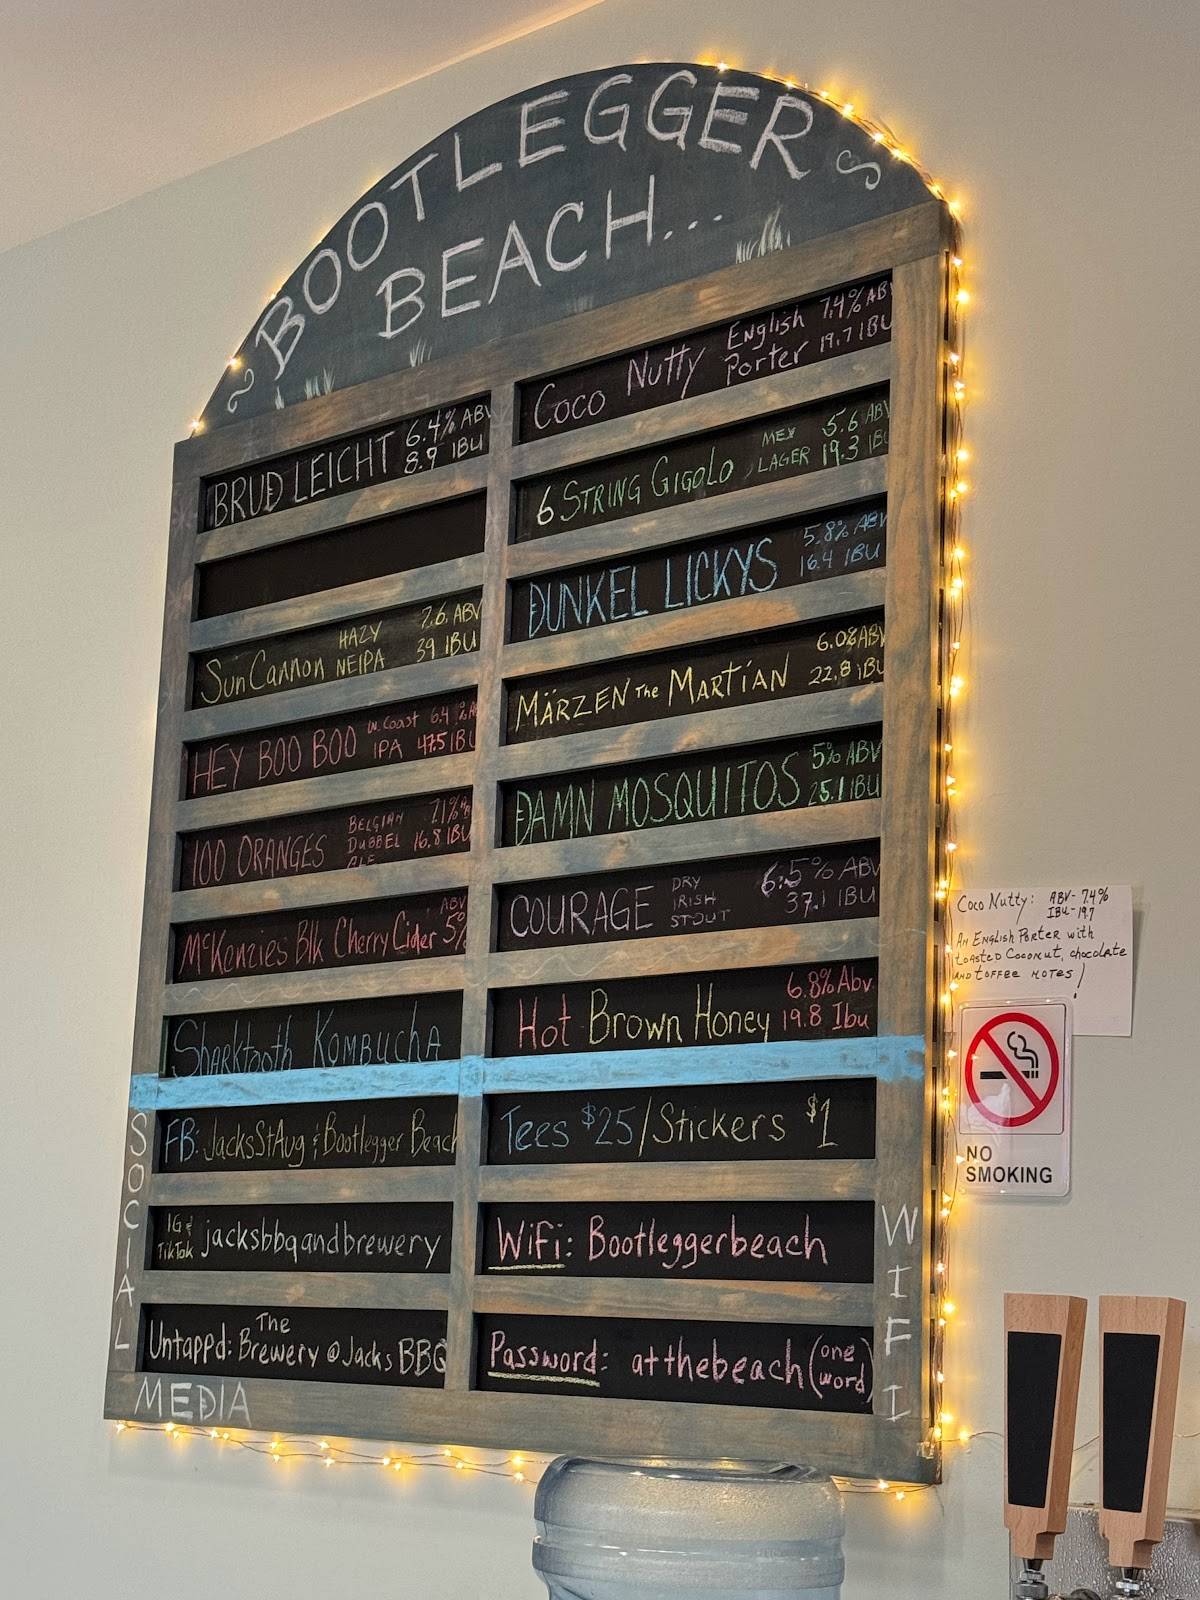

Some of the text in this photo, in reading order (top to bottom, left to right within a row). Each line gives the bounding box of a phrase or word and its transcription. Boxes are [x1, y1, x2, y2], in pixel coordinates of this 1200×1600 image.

[255, 70, 813, 380] BOOTLEGGER
[627, 343, 706, 400] Nutty
[724, 341, 806, 386] Porter
[405, 408, 456, 447] 6.4%
[822, 407, 859, 439] 5.6
[294, 431, 396, 503] LEICHT
[404, 434, 483, 474] 8.9 IBU
[757, 446, 811, 474] LAGER
[822, 435, 859, 467] 19.3
[536, 485, 555, 526] 6
[803, 518, 849, 548] 5.8%
[799, 543, 880, 577] 16.4 IBU
[528, 537, 778, 639] DUNKEL LICKYS
[453, 599, 482, 625] ABV
[339, 621, 382, 649] HAZY
[416, 631, 477, 663] 39 IBU
[336, 649, 385, 678] NEIPA
[808, 660, 852, 686] 22.8
[192, 726, 357, 794] HEY BOO BOO
[374, 740, 402, 759] IPA
[810, 738, 883, 770] 5% ABV
[515, 752, 801, 847] DAMN MOSQUITOS
[849, 773, 880, 801] IBU
[349, 812, 403, 834] BELGIAN
[413, 828, 441, 852] 16.8
[192, 833, 327, 887] 100 ORANGES
[672, 875, 701, 892] DRY
[440, 896, 466, 915] ABV
[509, 885, 654, 938] COURAGE
[673, 893, 717, 911] IRISH
[784, 886, 875, 919] 37.1 IBU
[670, 909, 731, 929] STOUT
[1067, 924, 1094, 942] with
[295, 919, 324, 967] Blk
[334, 914, 389, 958] Cherry
[392, 910, 437, 956] Cider
[786, 968, 835, 1000] 6.8%
[518, 982, 771, 1050] Hot Brown Honey
[782, 1004, 823, 1031] 19.8
[165, 1117, 200, 1163] FB:
[323, 1111, 404, 1164] Bootlegger
[500, 1105, 570, 1155] Tees
[806, 1092, 839, 1149] $1
[966, 1145, 992, 1162] NO
[966, 1166, 1053, 1184] SMOKING
[113, 1112, 147, 1350] SOCIAL
[588, 1213, 829, 1270] Bootleggerbeach
[158, 1240, 194, 1260] TikTok
[255, 1312, 292, 1334] The
[881, 1203, 919, 1423] WIFI
[239, 1326, 319, 1368] Brewery
[398, 1337, 448, 1377] BBQ
[488, 1330, 610, 1376] Password:
[134, 1377, 252, 1427] MEDIA
